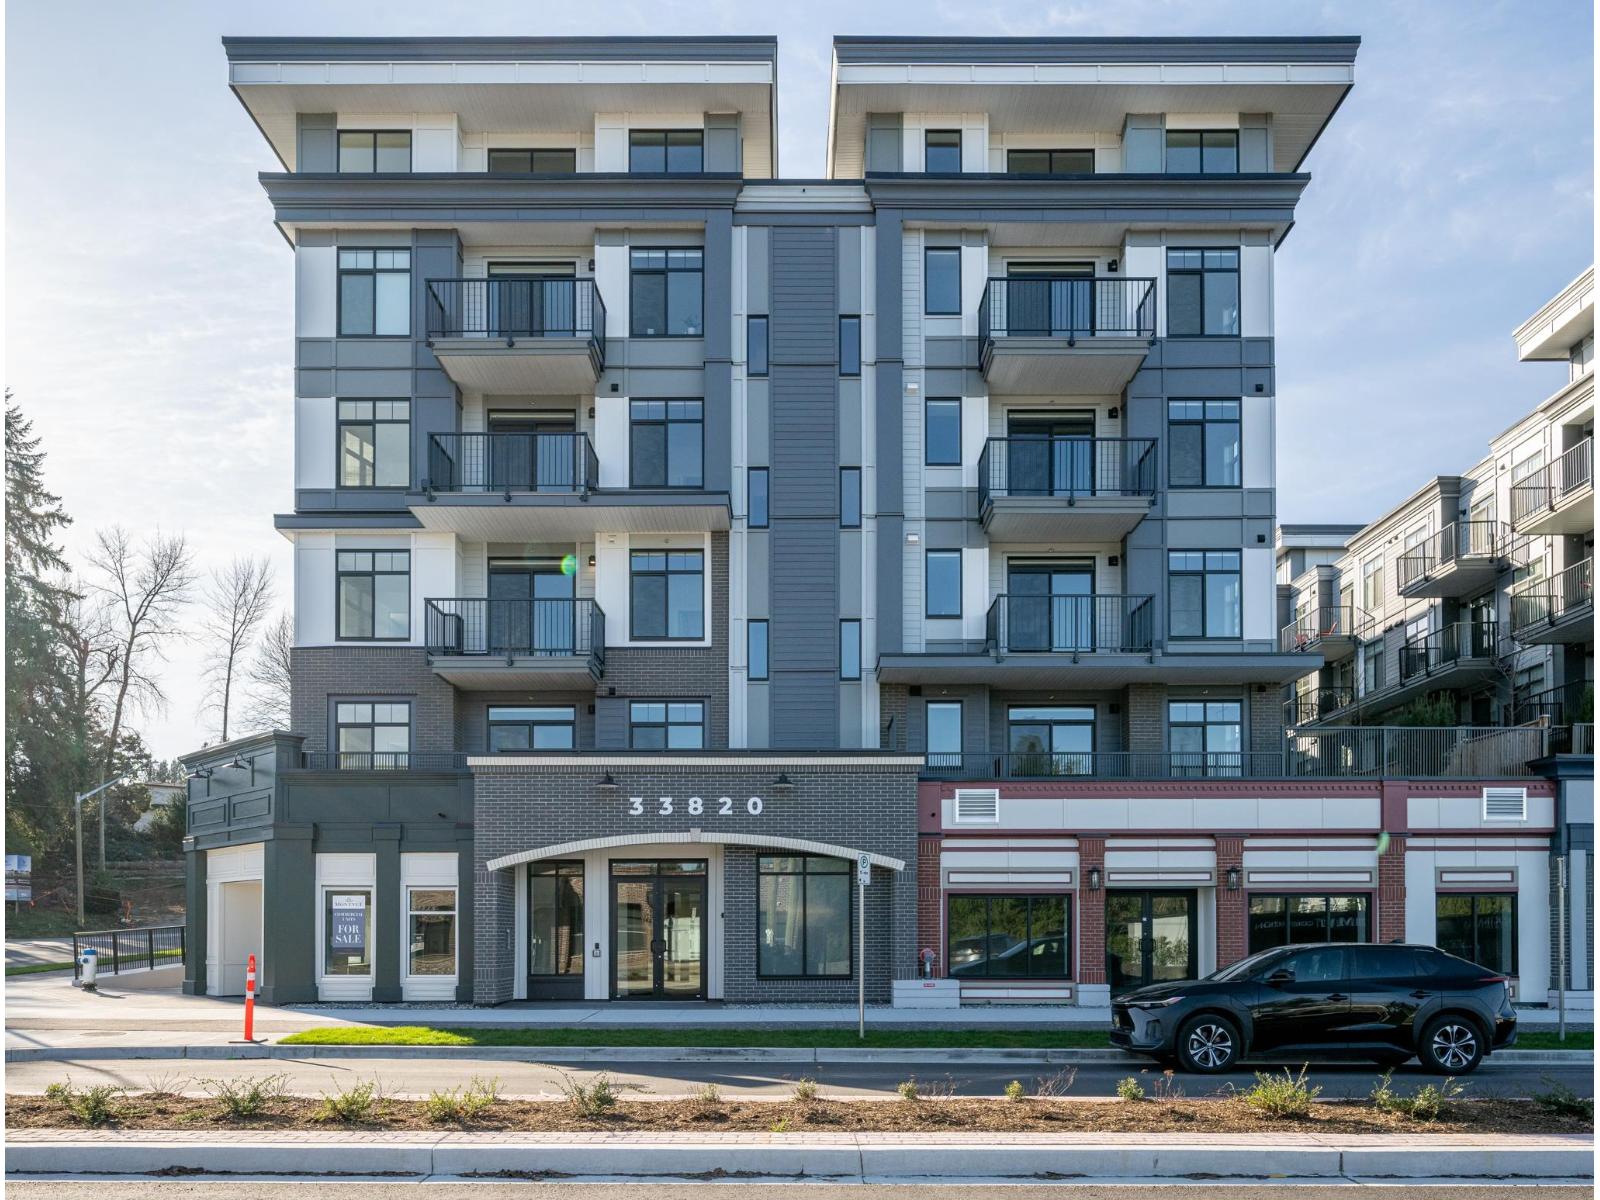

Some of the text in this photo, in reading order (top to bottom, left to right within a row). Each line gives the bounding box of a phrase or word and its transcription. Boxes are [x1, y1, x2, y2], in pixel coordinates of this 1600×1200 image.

[629, 796, 763, 815] 33820
[338, 924, 359, 934] FOR
[335, 934, 362, 944] SALE
